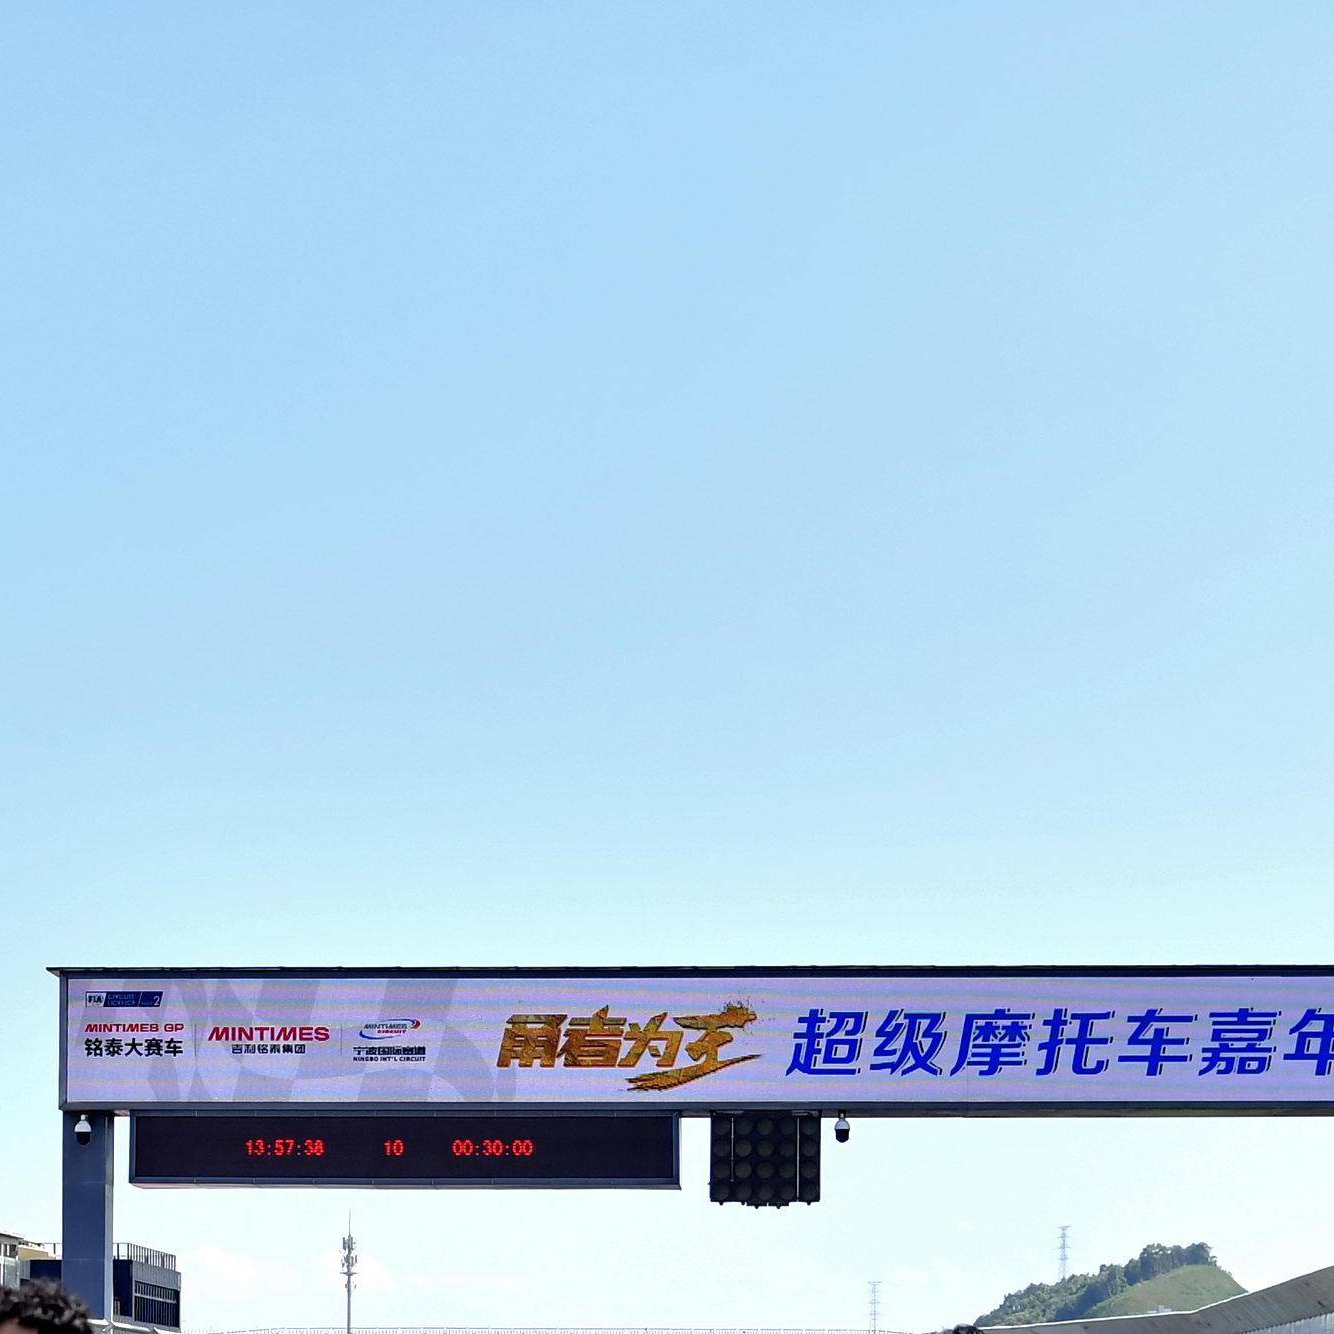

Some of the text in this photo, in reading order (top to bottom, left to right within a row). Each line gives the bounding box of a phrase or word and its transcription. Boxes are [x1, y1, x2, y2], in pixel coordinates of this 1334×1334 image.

[85, 1024, 184, 1032] MINTIMES GP
[208, 1026, 331, 1042] MINTIMES
[84, 1038, 184, 1057] 铭泰大赛车
[383, 1139, 404, 1156] 10
[452, 1139, 534, 1156] 00:30:00
